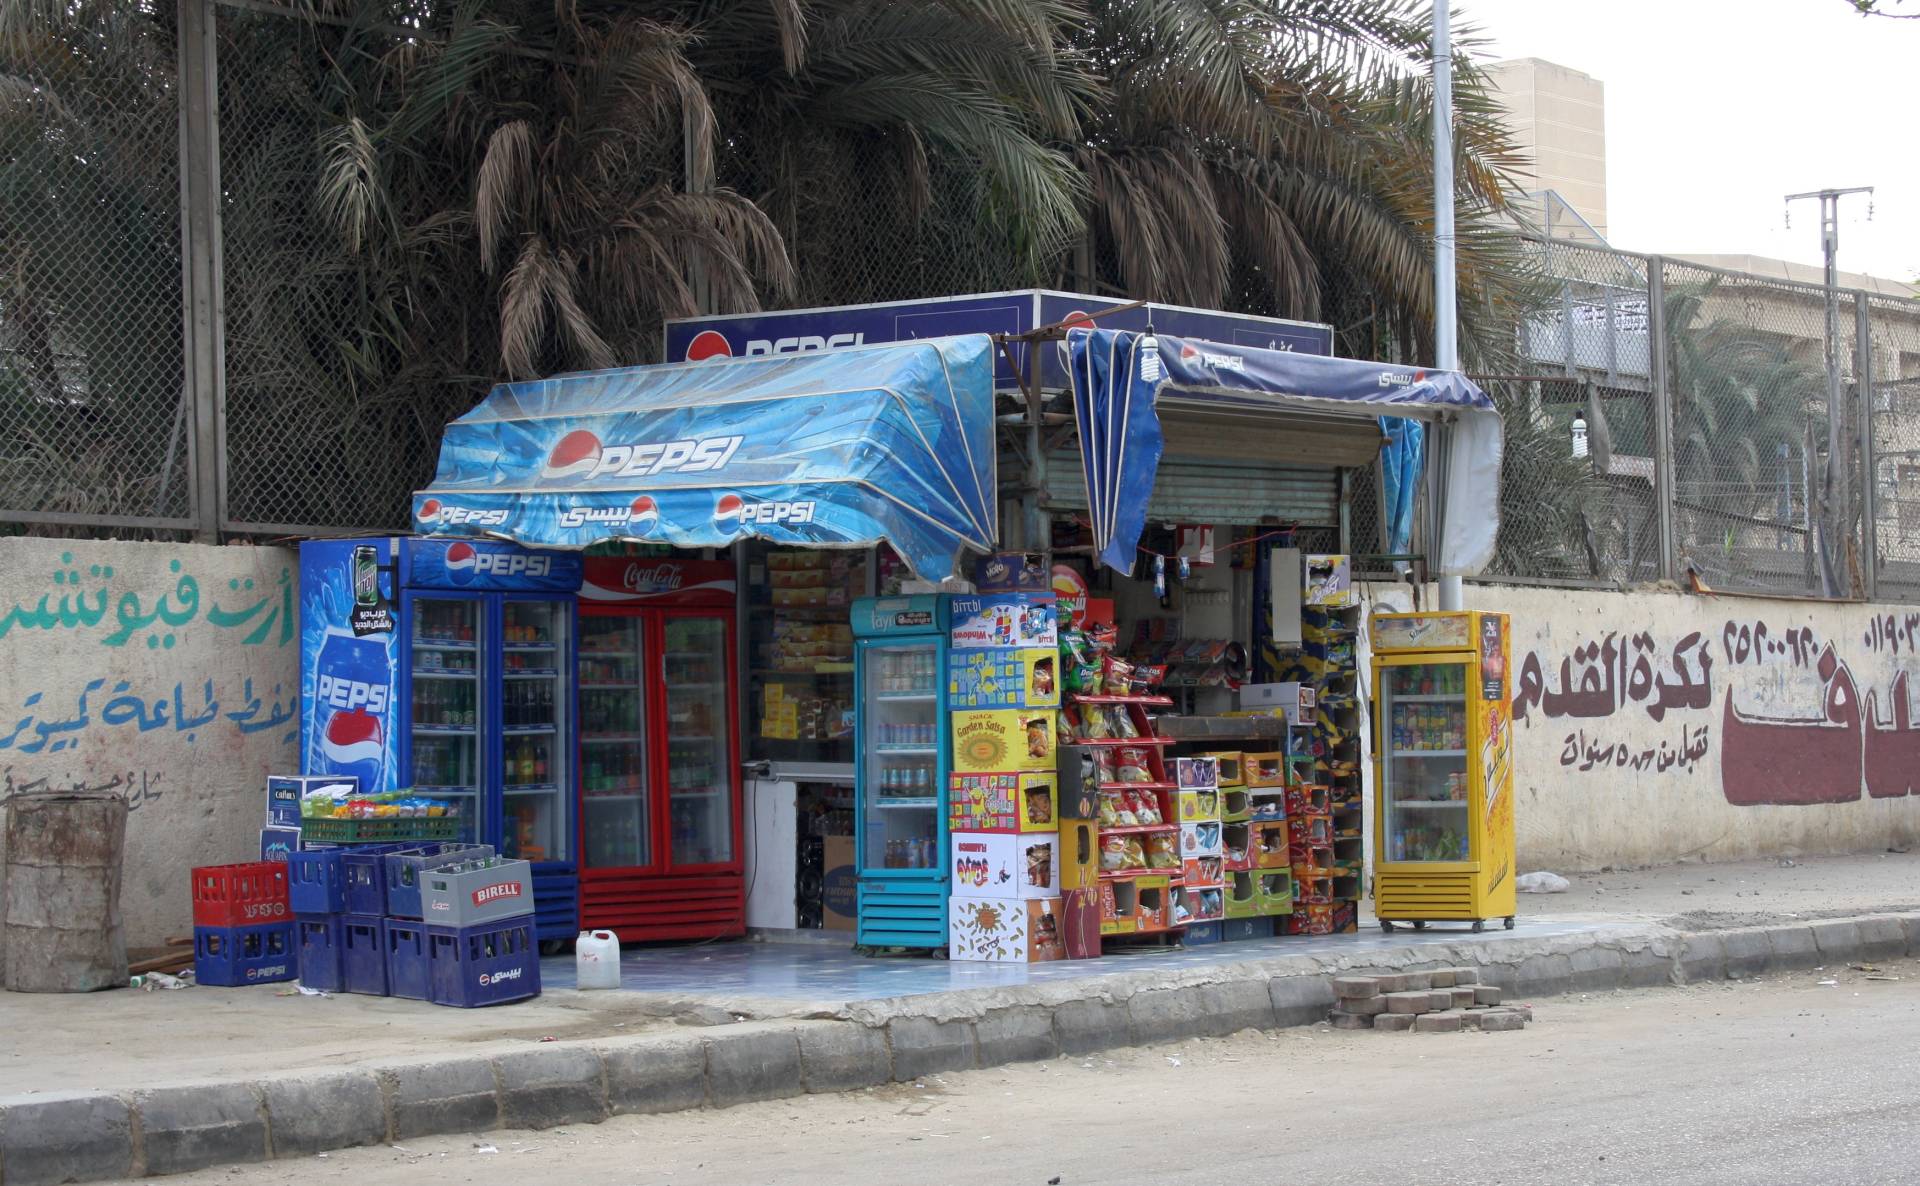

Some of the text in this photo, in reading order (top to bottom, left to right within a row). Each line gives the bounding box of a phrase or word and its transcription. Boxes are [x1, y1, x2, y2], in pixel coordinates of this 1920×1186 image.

[1202, 352, 1246, 371] PEPSI
[584, 435, 744, 480] PEPSI
[439, 506, 510, 525] PEPSI
[738, 501, 816, 525] PEPSI
[473, 553, 552, 577] PEPSI
[318, 674, 389, 713] PEPSI
[102, 678, 219, 742] طباعة
[957, 720, 1006, 737] Garden Salsa
[1560, 728, 1615, 771] سنوات
[1656, 740, 1676, 773] من
[477, 883, 518, 902] BIRELL
[257, 965, 286, 978] PEPSI
